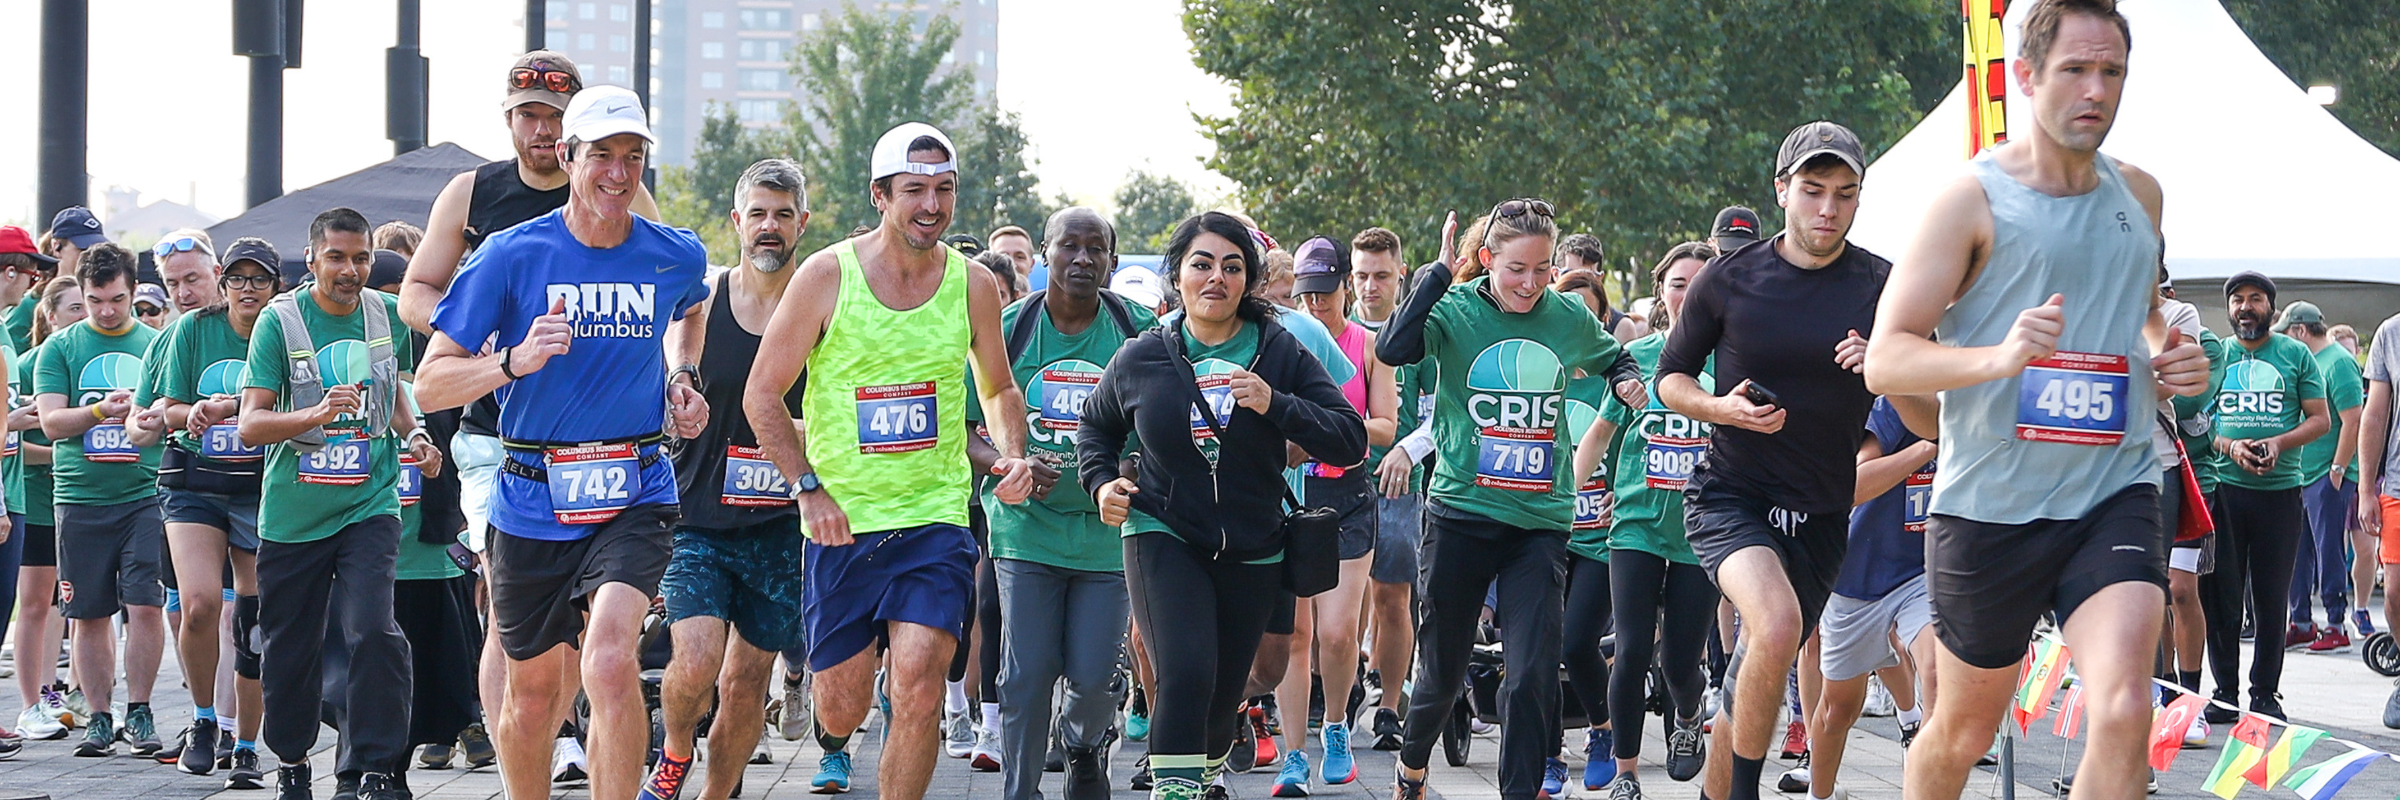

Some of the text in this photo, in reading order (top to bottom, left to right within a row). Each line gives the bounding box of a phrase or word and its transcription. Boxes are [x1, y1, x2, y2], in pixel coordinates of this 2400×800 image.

[546, 282, 656, 322] RUN
[567, 320, 653, 338] lumbus
[865, 386, 900, 394] COLUMBUS
[2036, 378, 2113, 422] 495
[2218, 392, 2284, 414] CRIS
[870, 403, 927, 436] 476
[1468, 393, 1562, 428] CRIS
[92, 429, 133, 450] 692
[556, 446, 595, 456] COLUMBUS
[309, 444, 361, 471] 592
[576, 452, 609, 460] COMPANY
[1493, 443, 1545, 475] 719
[561, 466, 629, 503] 742
[735, 465, 786, 493] 302
